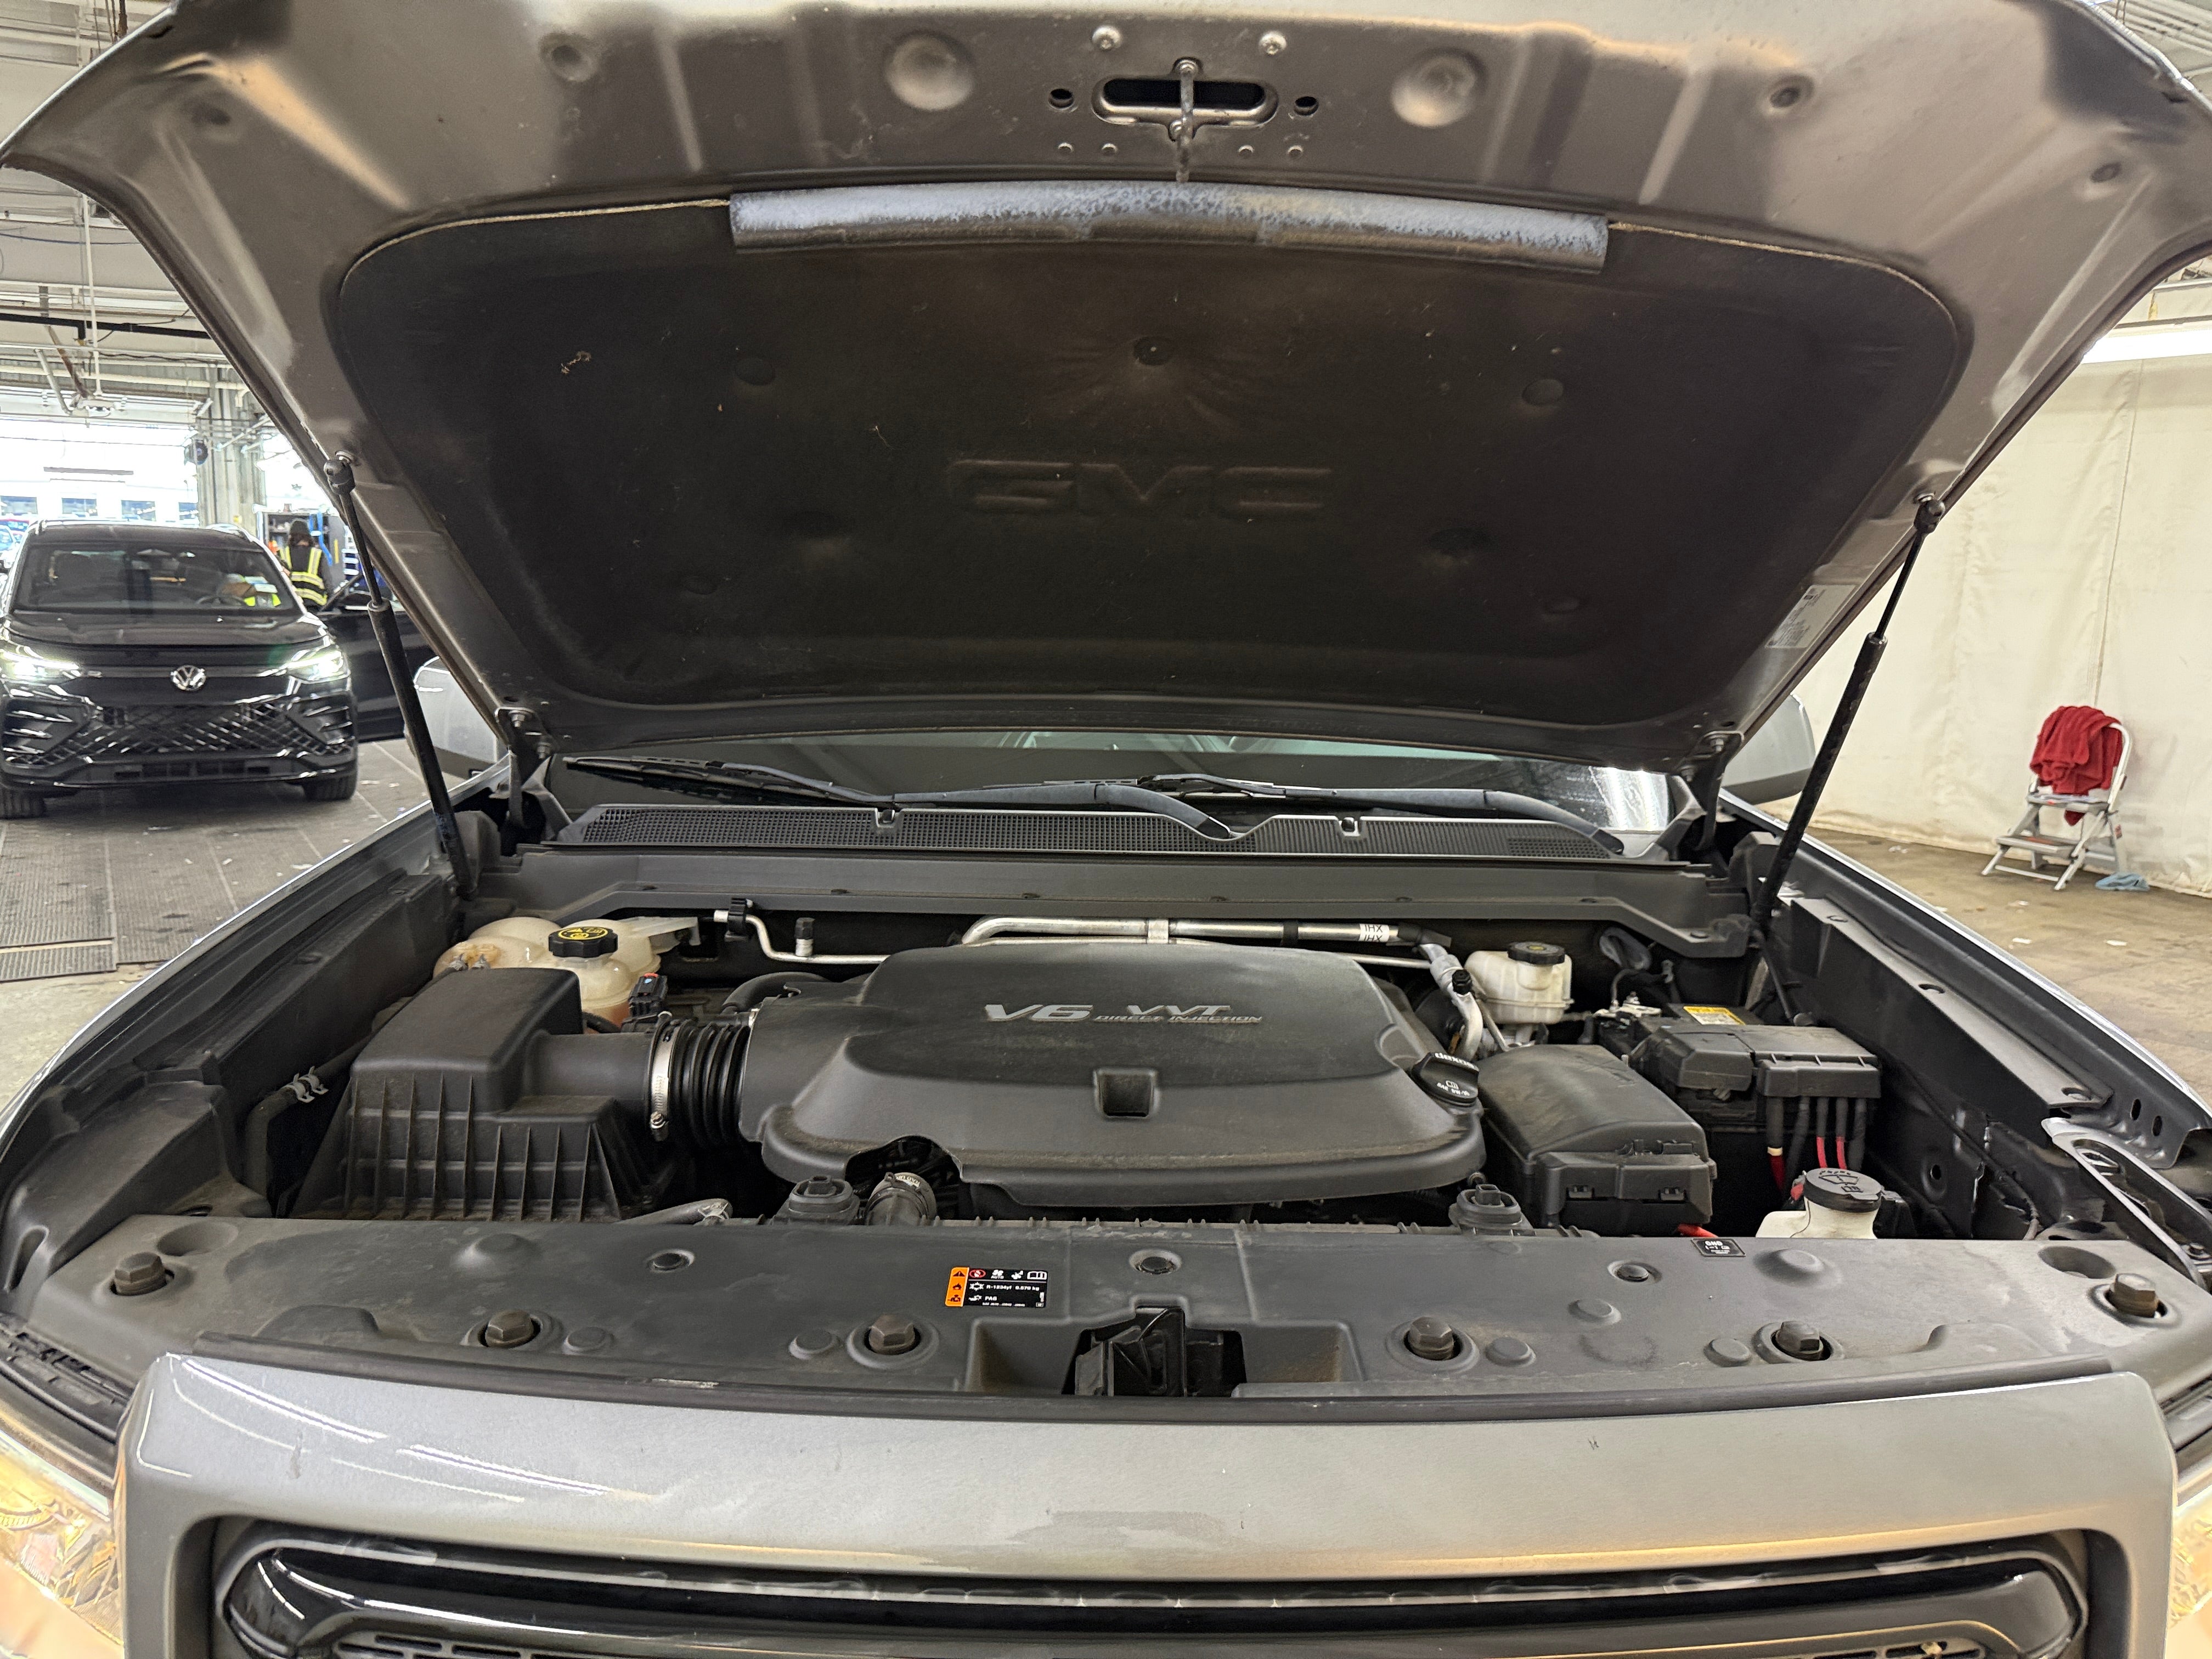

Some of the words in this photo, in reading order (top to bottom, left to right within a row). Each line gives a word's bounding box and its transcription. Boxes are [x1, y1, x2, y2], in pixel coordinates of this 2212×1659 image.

[947, 459, 1332, 516] GMC
[1364, 924, 1383, 933] IHX
[984, 1005, 1093, 1022] V6
[1127, 1005, 1232, 1015] VVT
[1167, 1015, 1262, 1023] INJECTION
